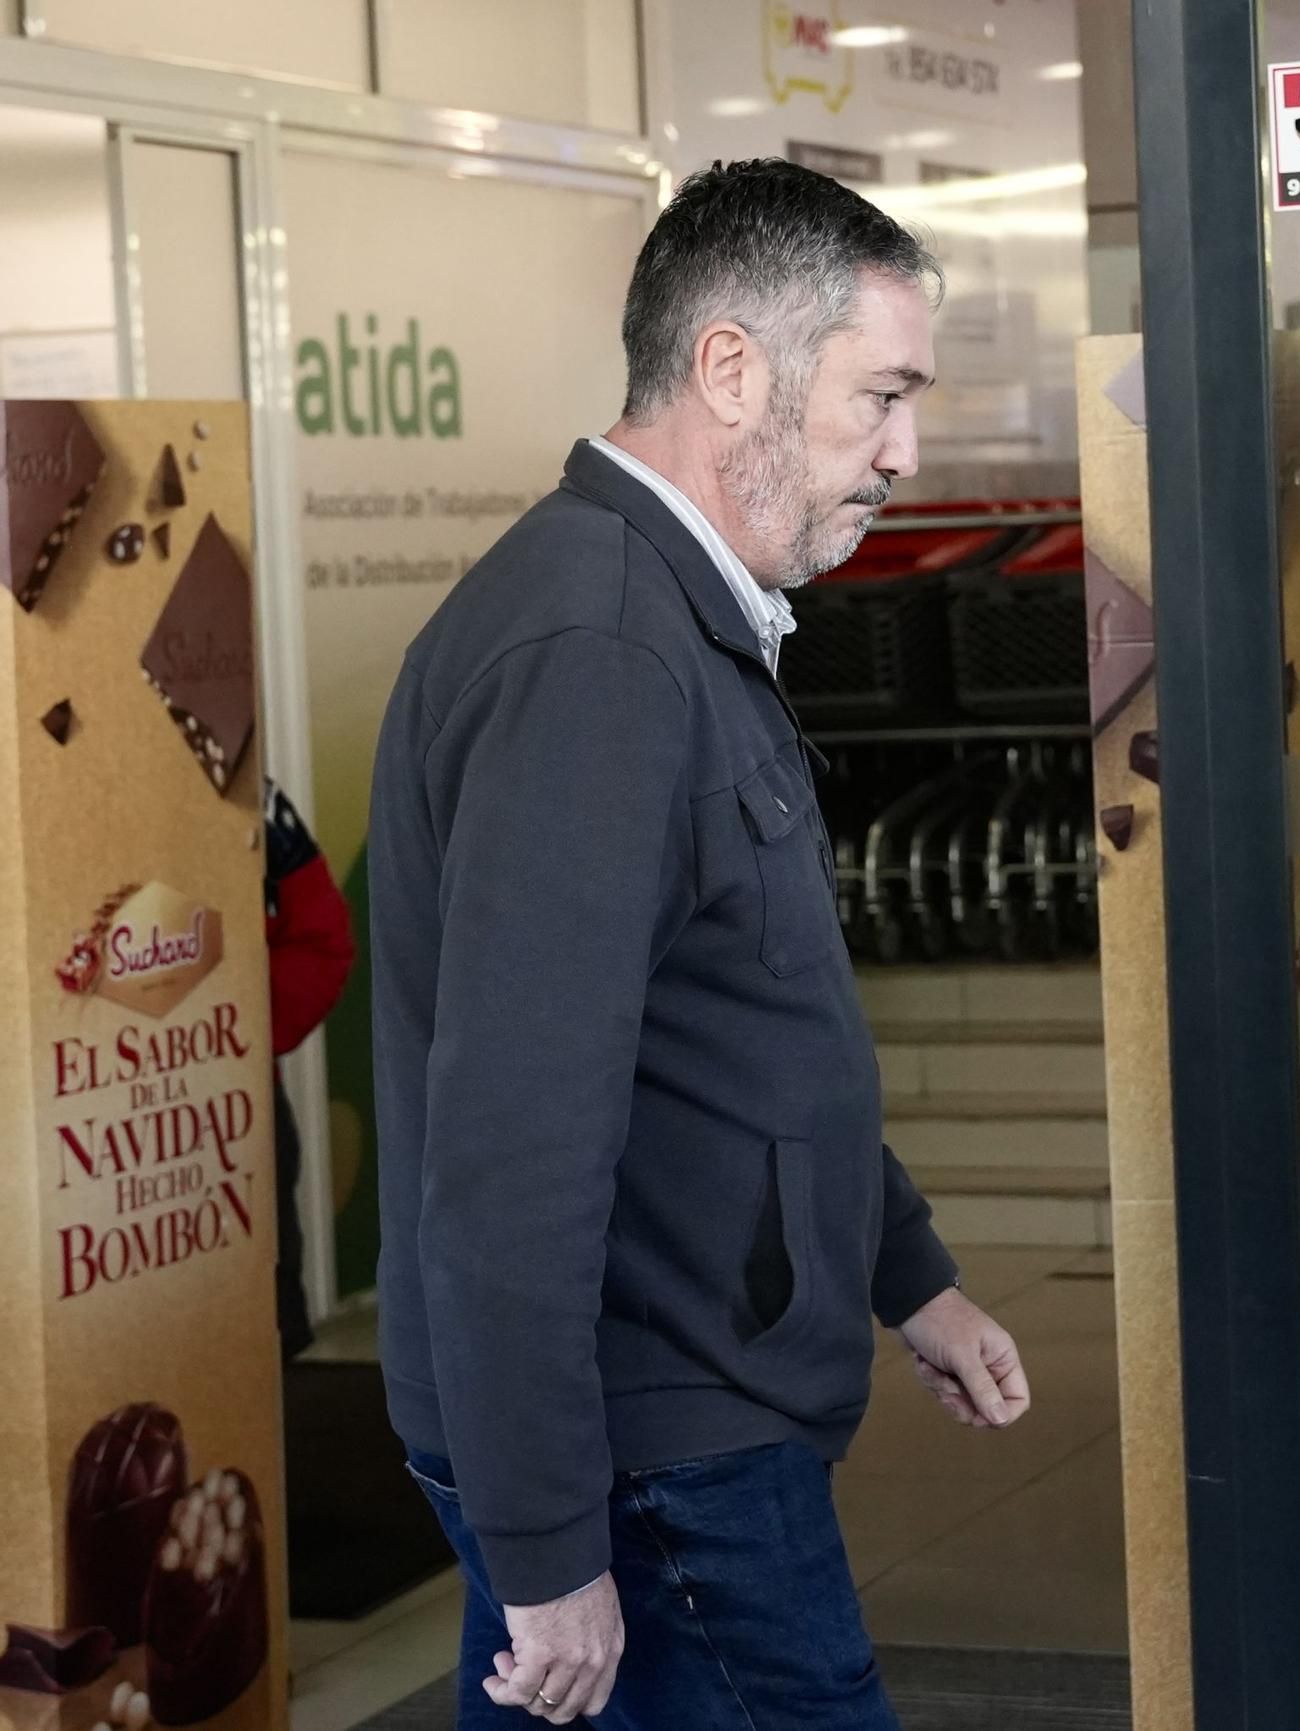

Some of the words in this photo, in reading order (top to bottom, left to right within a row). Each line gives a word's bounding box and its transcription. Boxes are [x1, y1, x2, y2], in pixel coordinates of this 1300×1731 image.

[296, 312, 463, 439] atida
[110, 907, 205, 977] Suchard
[54, 1037, 112, 1097] EL
[115, 1002, 251, 1083] SABOR
[130, 1083, 154, 1110] DE
[163, 1076, 188, 1101] LA
[56, 1088, 254, 1189] NAVIDAD
[57, 1172, 254, 1300] BOMBÓN
[116, 1162, 203, 1215] HECHO
